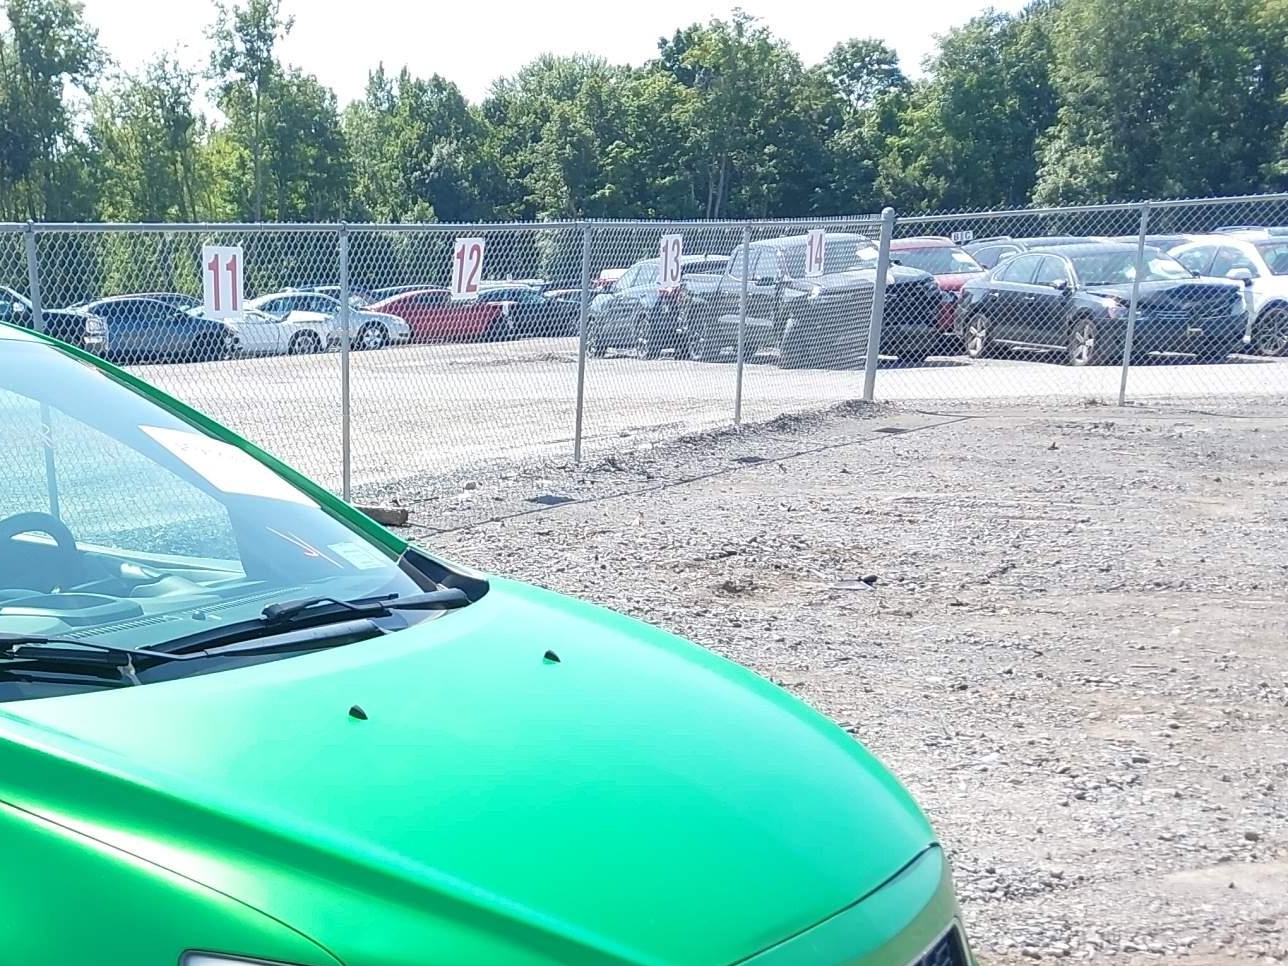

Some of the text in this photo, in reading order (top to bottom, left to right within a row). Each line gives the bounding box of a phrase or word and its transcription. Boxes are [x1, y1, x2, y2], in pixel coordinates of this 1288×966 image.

[456, 243, 481, 293] 12
[662, 239, 680, 282] 13
[808, 233, 823, 272] 14
[208, 254, 238, 311] 11
